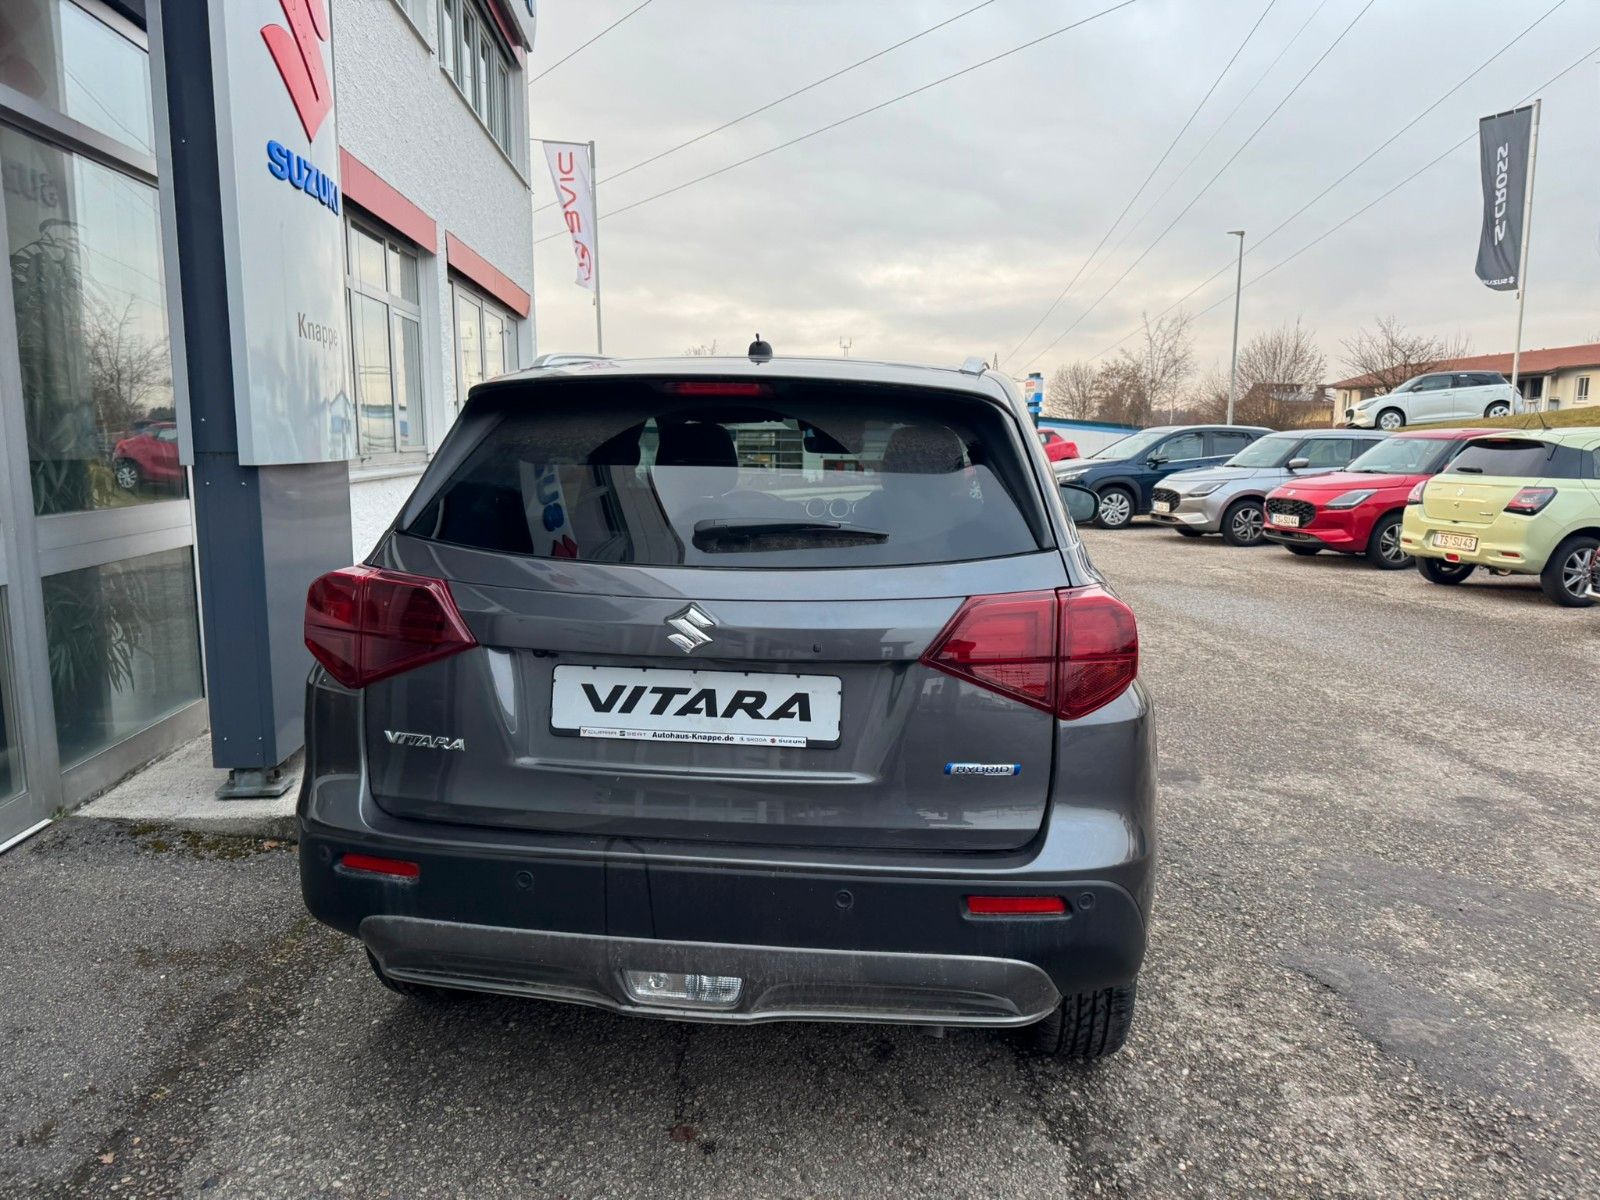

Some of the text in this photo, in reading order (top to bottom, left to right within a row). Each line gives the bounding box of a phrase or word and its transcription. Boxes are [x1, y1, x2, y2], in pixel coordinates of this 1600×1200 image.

[297, 311, 338, 351] Knappe
[580, 683, 812, 723] VITARA
[384, 729, 466, 752] VITARA
[652, 731, 734, 743] Autohaus-Knappe.de
[955, 765, 1010, 774] HYBRID
